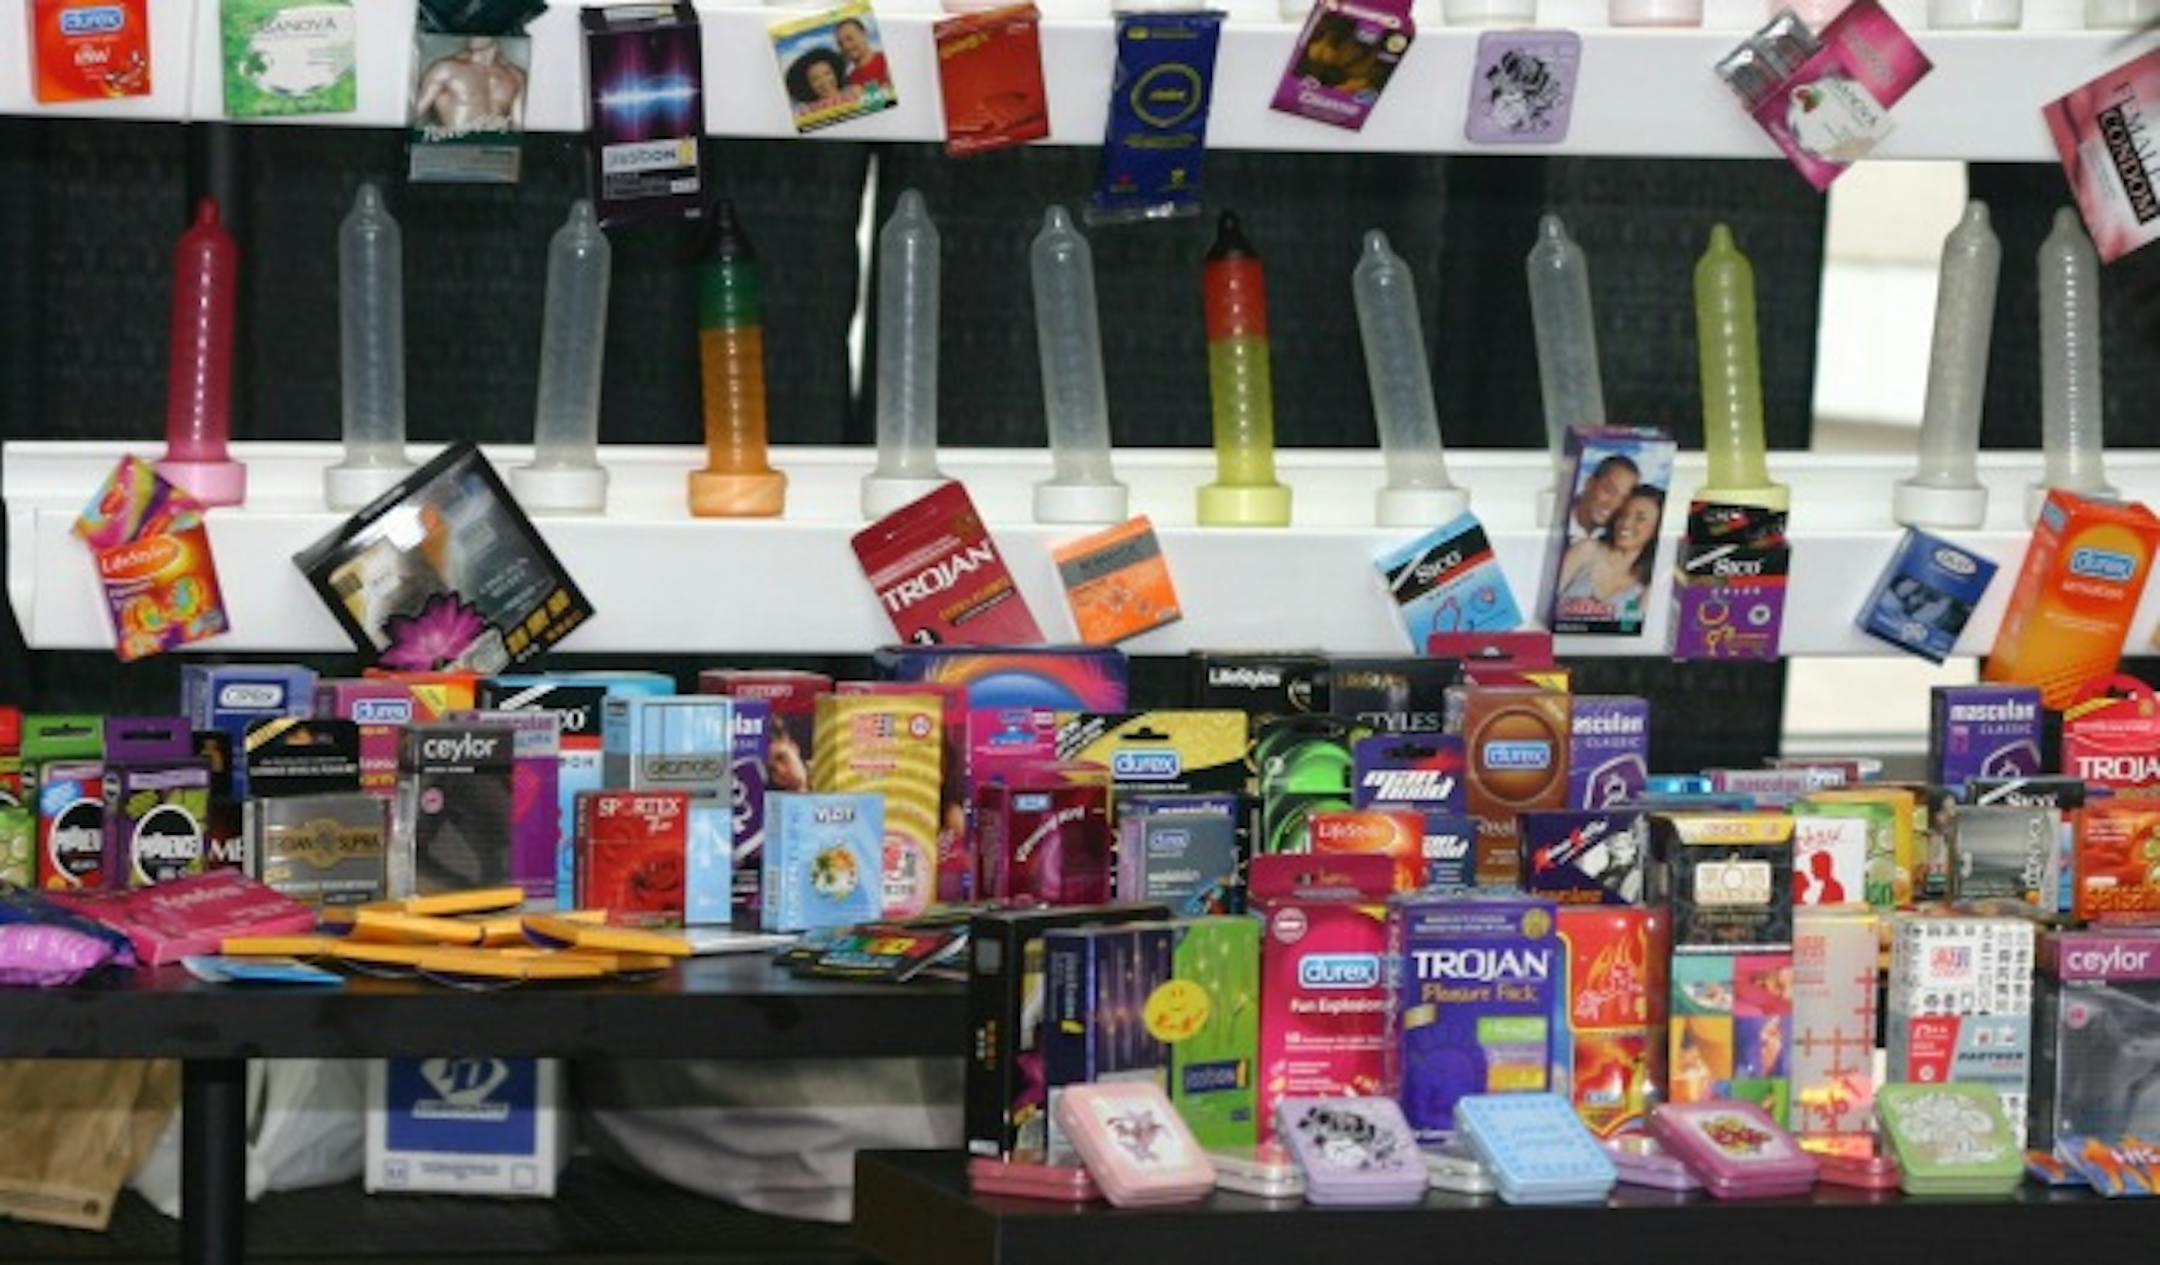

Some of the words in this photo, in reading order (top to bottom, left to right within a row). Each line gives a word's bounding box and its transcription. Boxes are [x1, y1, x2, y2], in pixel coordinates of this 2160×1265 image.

[2099, 109, 2157, 221] CONDOM
[881, 540, 996, 611] TROJAN
[2074, 551, 2134, 579] durex
[1208, 668, 1281, 687] LifeStyles
[357, 702, 407, 719] durex
[1950, 699, 2035, 721] masculan
[1572, 712, 1644, 734] asculan
[1980, 724, 2033, 735] CLASSIC
[424, 733, 499, 764] ceylor
[1585, 737, 1640, 748] CLASSIC
[1116, 754, 1176, 776] durex
[1488, 748, 1547, 766] durex
[2076, 757, 2160, 782] TROJA
[1151, 830, 1189, 847] durex
[1411, 950, 1549, 981] TROJAN
[2068, 945, 2151, 975] ceylor
[1304, 959, 1375, 984] durex
[1421, 983, 1490, 1003] Pleasure
[1497, 983, 1539, 1001] Pack
[1290, 999, 1315, 1012] Fun
